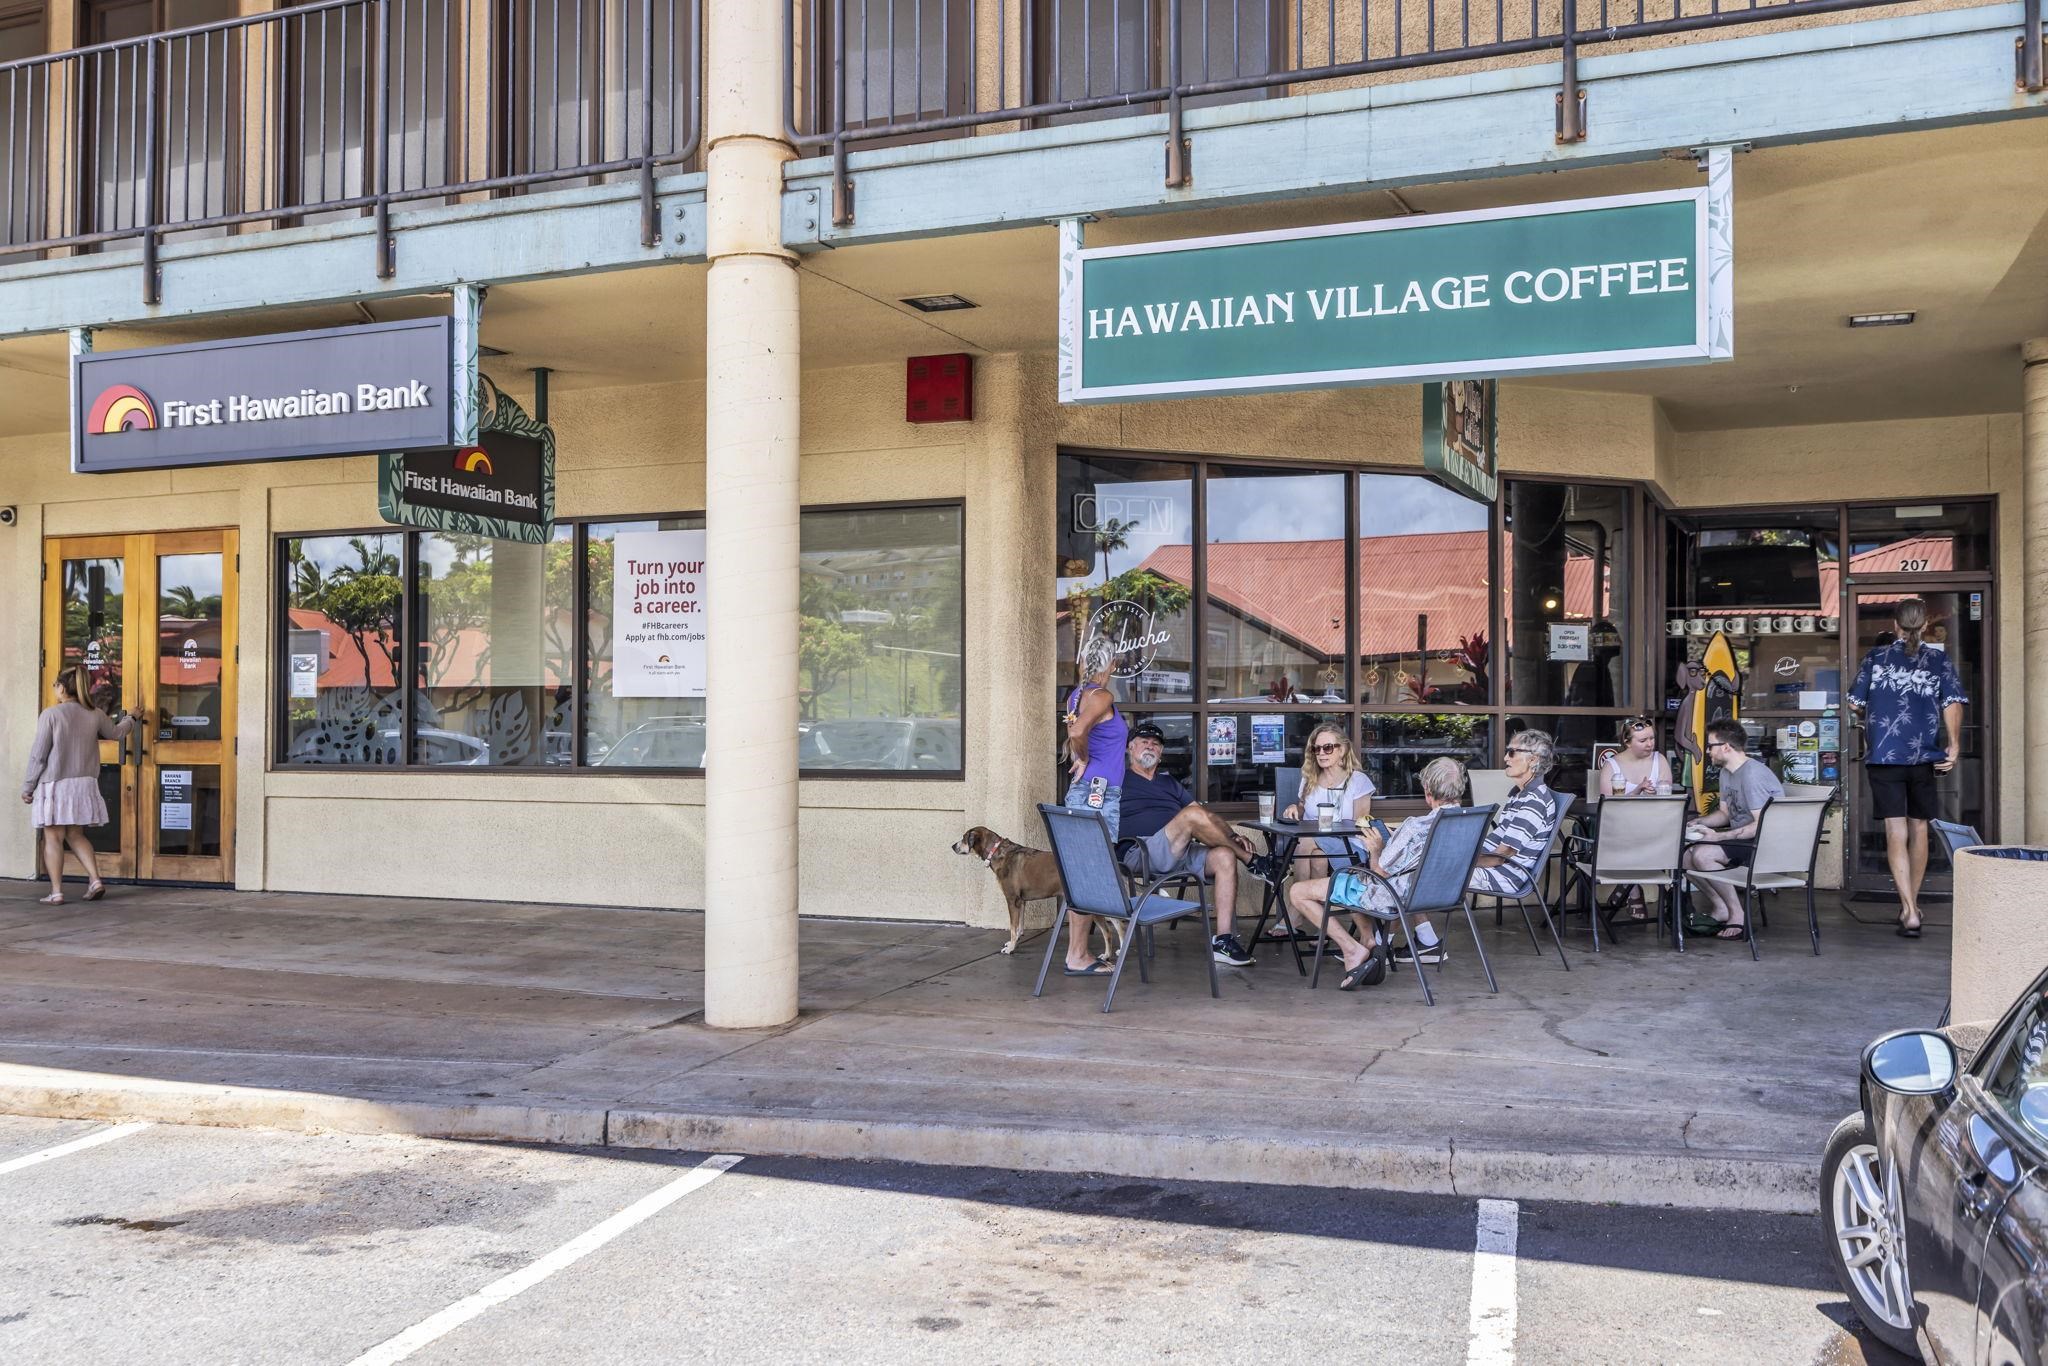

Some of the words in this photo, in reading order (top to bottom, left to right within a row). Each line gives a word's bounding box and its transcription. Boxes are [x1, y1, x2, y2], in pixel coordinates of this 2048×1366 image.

[1088, 291, 1295, 339] HAWAIIAN
[1306, 274, 1490, 320] VILLAGE
[1503, 257, 1689, 304] COFFEE
[163, 399, 223, 428] First
[229, 389, 351, 422] Hawaiian
[357, 379, 430, 412] Bank
[404, 470, 438, 493] First
[440, 477, 502, 503] Hawaiian
[504, 488, 538, 509] Bank
[1079, 497, 1171, 533] OPEN
[628, 560, 664, 575] Turn
[667, 561, 705, 578] your
[1900, 560, 1929, 571] 207
[634, 579, 660, 599] job
[664, 579, 695, 594] into
[633, 601, 642, 613] a
[647, 600, 701, 613] career.
[1096, 605, 1122, 622] VALLEY
[1126, 606, 1143, 619] ISLE
[625, 634, 646, 643] Apply
[657, 633, 706, 642] fhb.com/jobs
